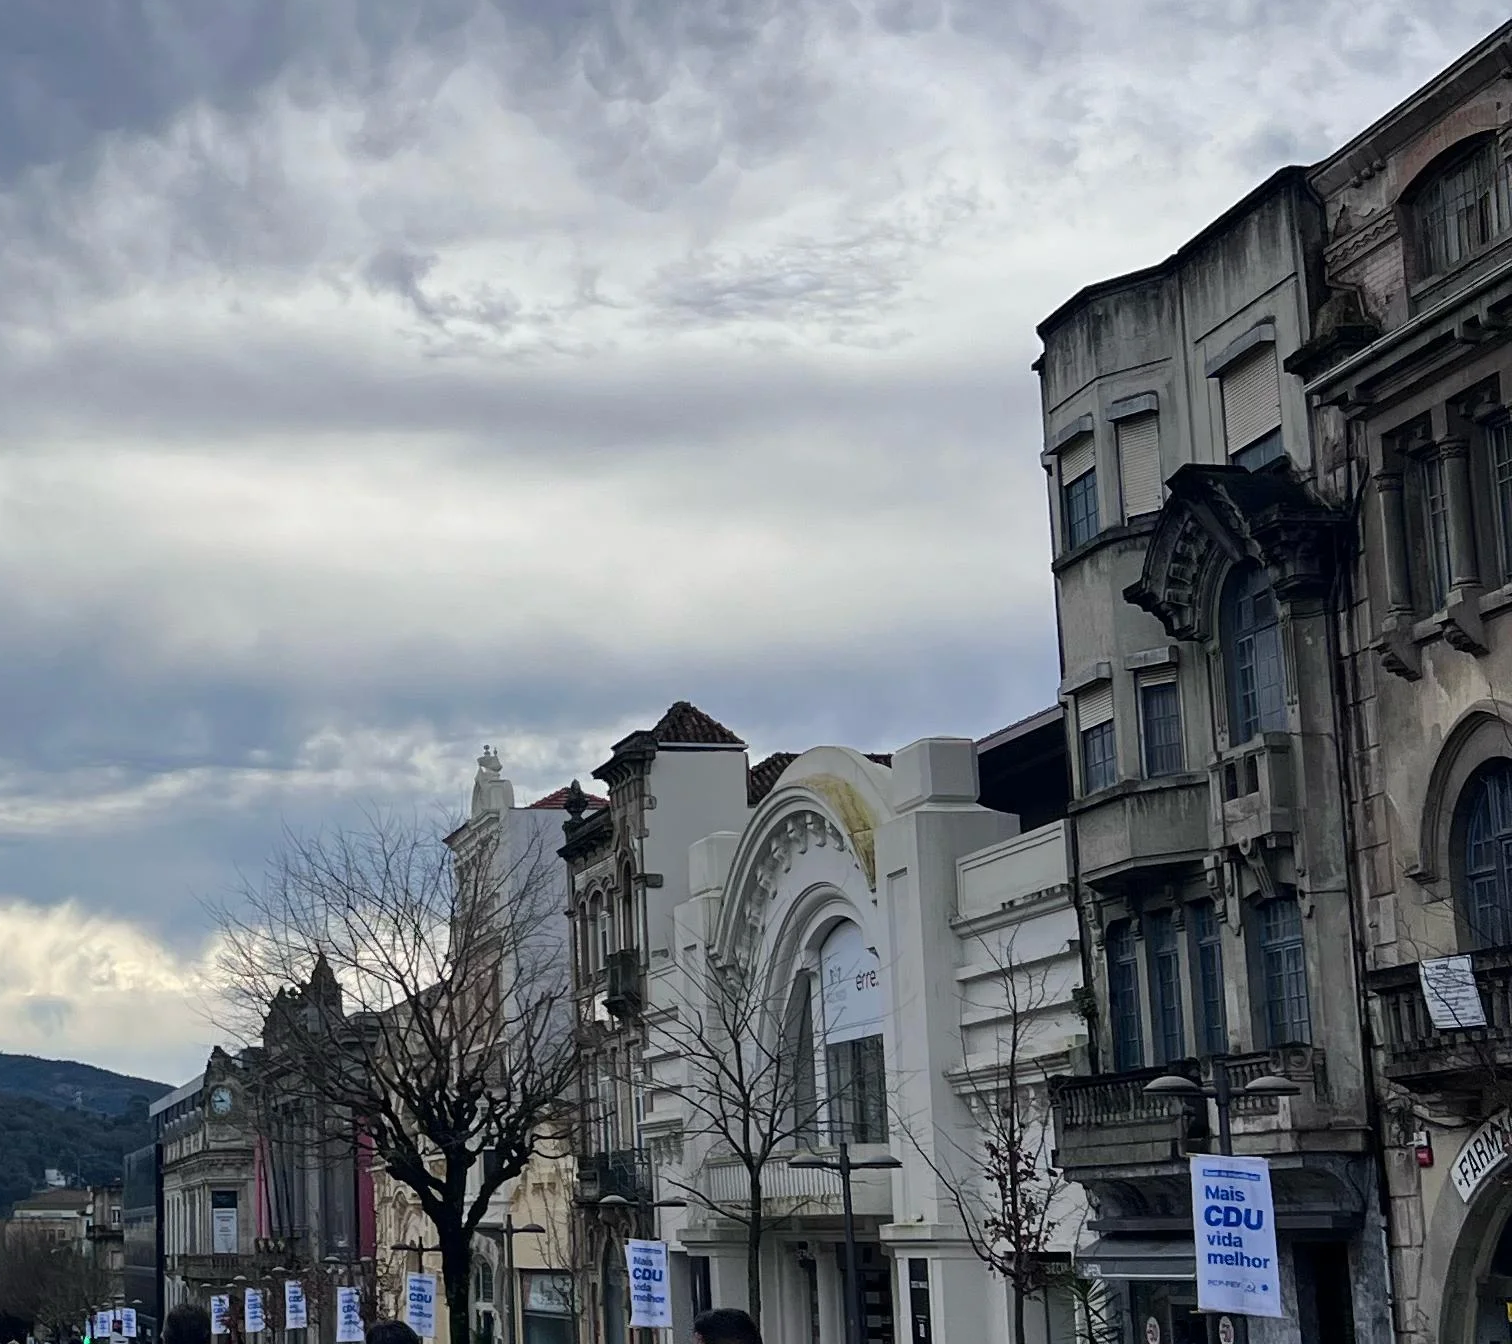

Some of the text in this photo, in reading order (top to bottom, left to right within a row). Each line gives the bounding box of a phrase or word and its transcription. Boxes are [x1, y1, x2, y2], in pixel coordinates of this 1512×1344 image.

[1205, 1185, 1245, 1202] Mais
[1204, 1205, 1263, 1231] CDU
[1206, 1231, 1243, 1248] vida
[633, 1256, 654, 1266] Mais
[1207, 1252, 1270, 1269] melhor
[633, 1267, 663, 1282] CDU
[633, 1283, 652, 1292] vida
[409, 1292, 432, 1304] CDU
[633, 1293, 665, 1303] melhor
